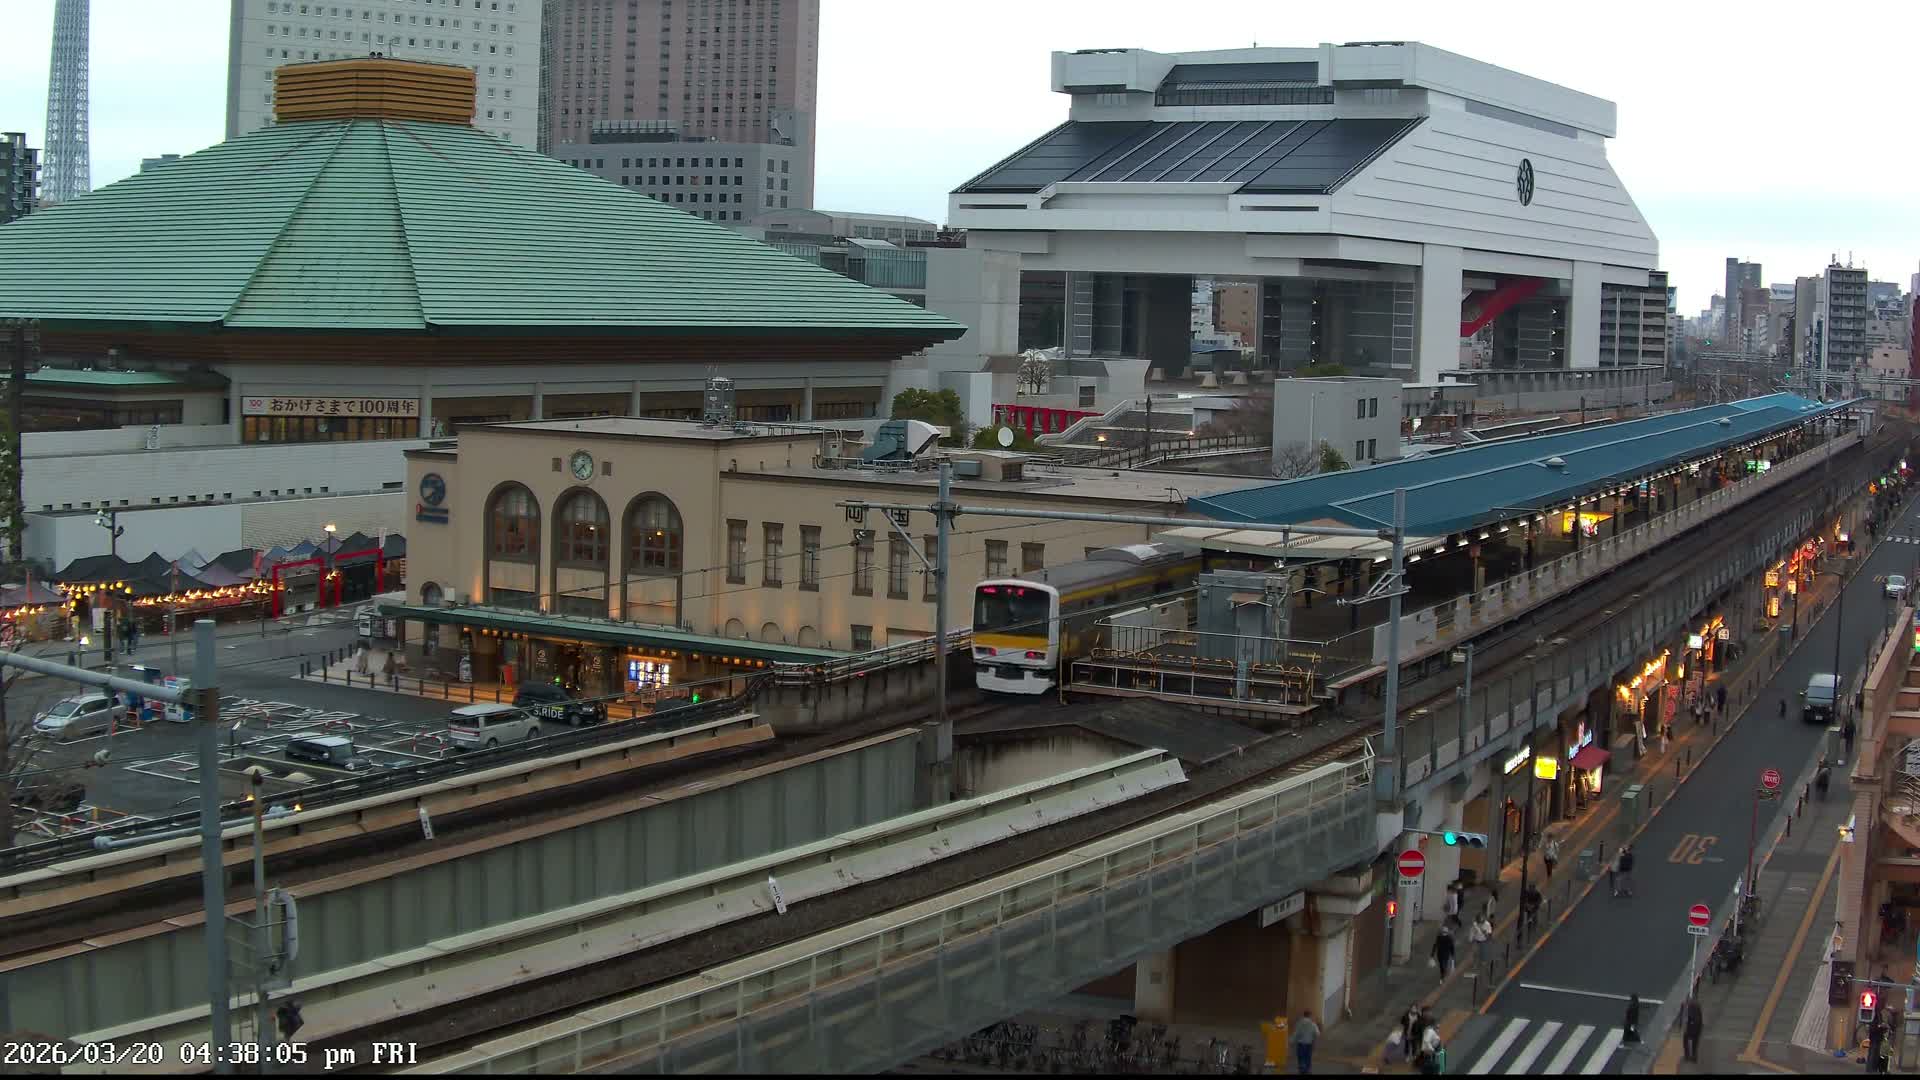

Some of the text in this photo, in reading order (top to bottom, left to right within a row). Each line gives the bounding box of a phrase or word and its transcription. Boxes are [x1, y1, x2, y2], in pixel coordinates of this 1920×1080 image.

[271, 399, 415, 415] おかげさまで100周年
